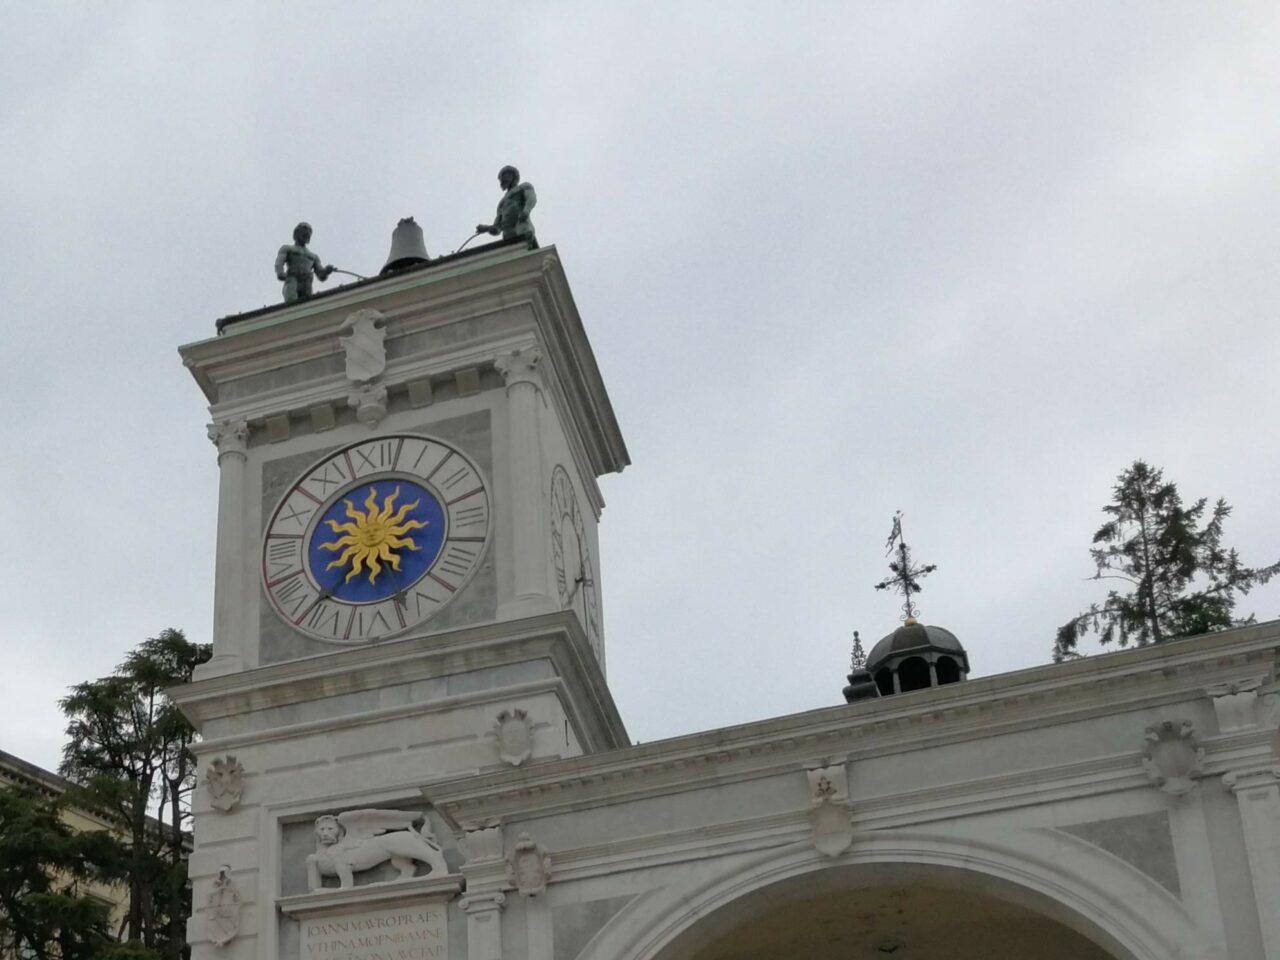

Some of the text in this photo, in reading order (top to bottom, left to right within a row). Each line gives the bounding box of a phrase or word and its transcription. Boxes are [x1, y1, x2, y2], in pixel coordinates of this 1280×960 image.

[356, 442, 392, 472] XII
[413, 445, 428, 469] I
[310, 462, 346, 495] XI
[442, 467, 470, 490] II
[280, 503, 311, 526] X
[456, 506, 484, 528] III
[439, 547, 476, 577] IIII
[275, 577, 308, 616] VIII
[416, 591, 441, 617] V
[307, 602, 339, 636] VII
[359, 610, 391, 636] VI
